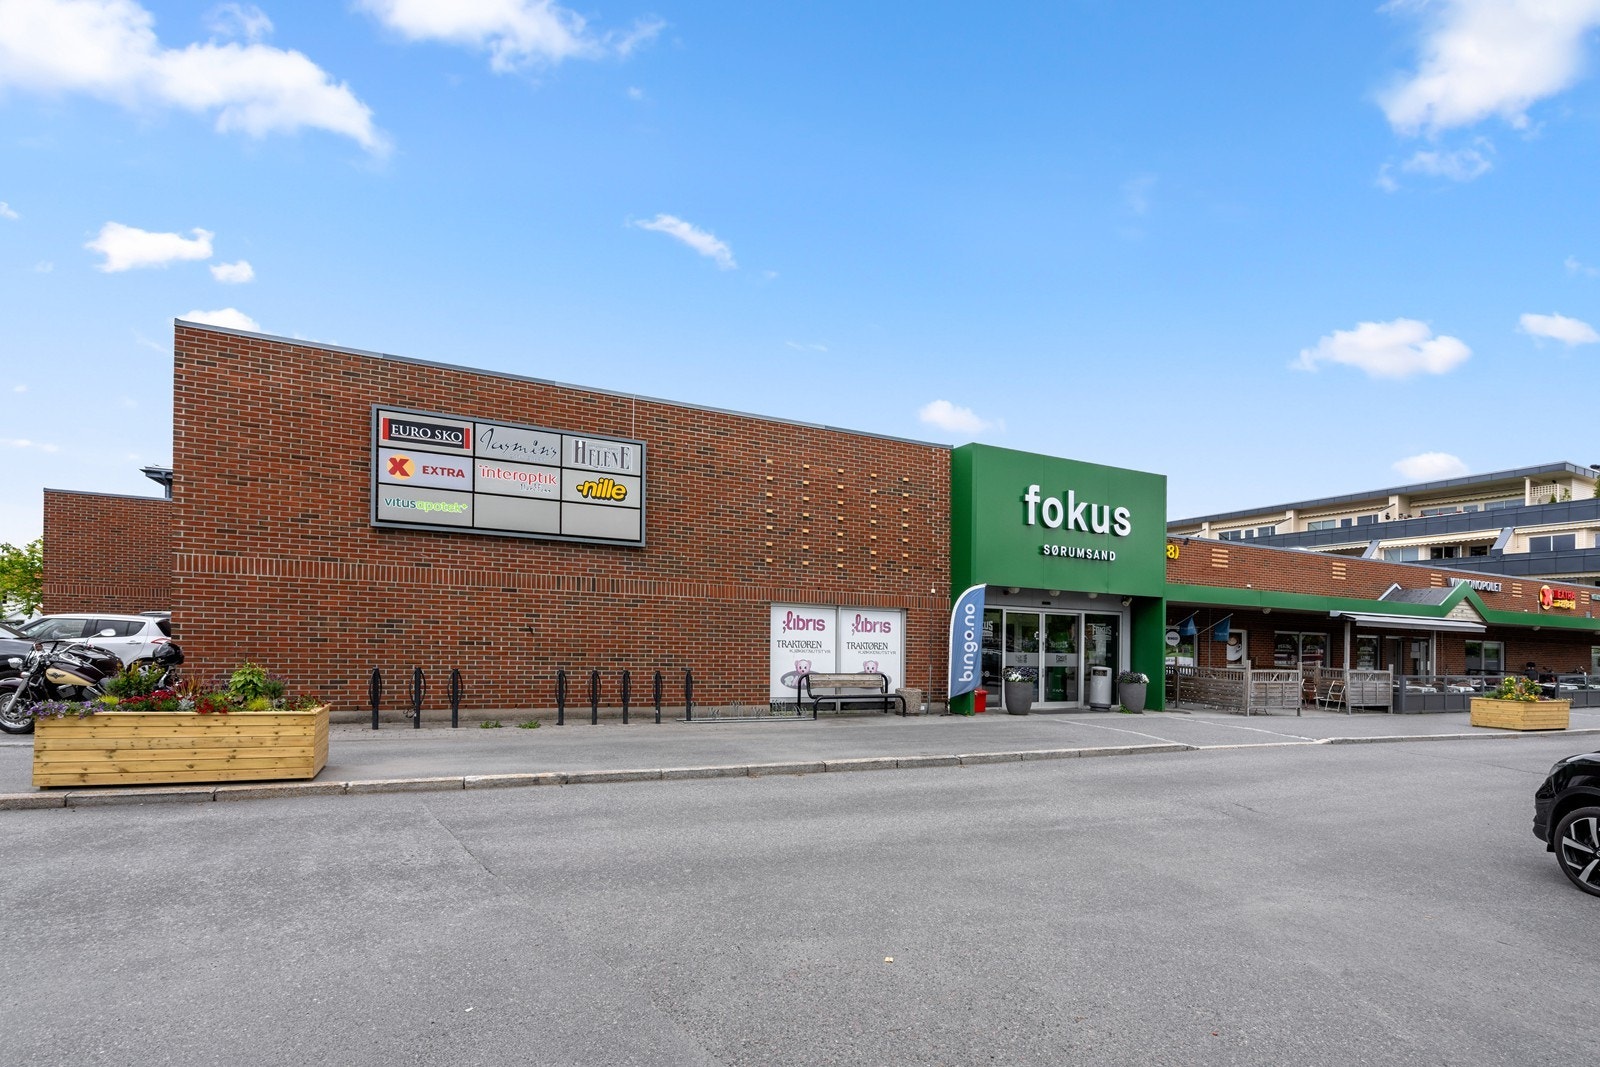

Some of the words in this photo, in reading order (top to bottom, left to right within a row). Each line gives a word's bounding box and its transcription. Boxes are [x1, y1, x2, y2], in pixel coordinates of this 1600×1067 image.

[391, 424, 431, 438] EURO
[434, 429, 463, 442] SKO
[422, 465, 466, 479] EXTRA
[479, 464, 557, 485] interoptik
[1024, 484, 1132, 537] fokus
[1043, 544, 1116, 561] SØRUMSAND
[777, 640, 822, 649] TRAKTØREN
[846, 641, 888, 650] TRAKTØREN
[958, 603, 979, 682] bingo.no
